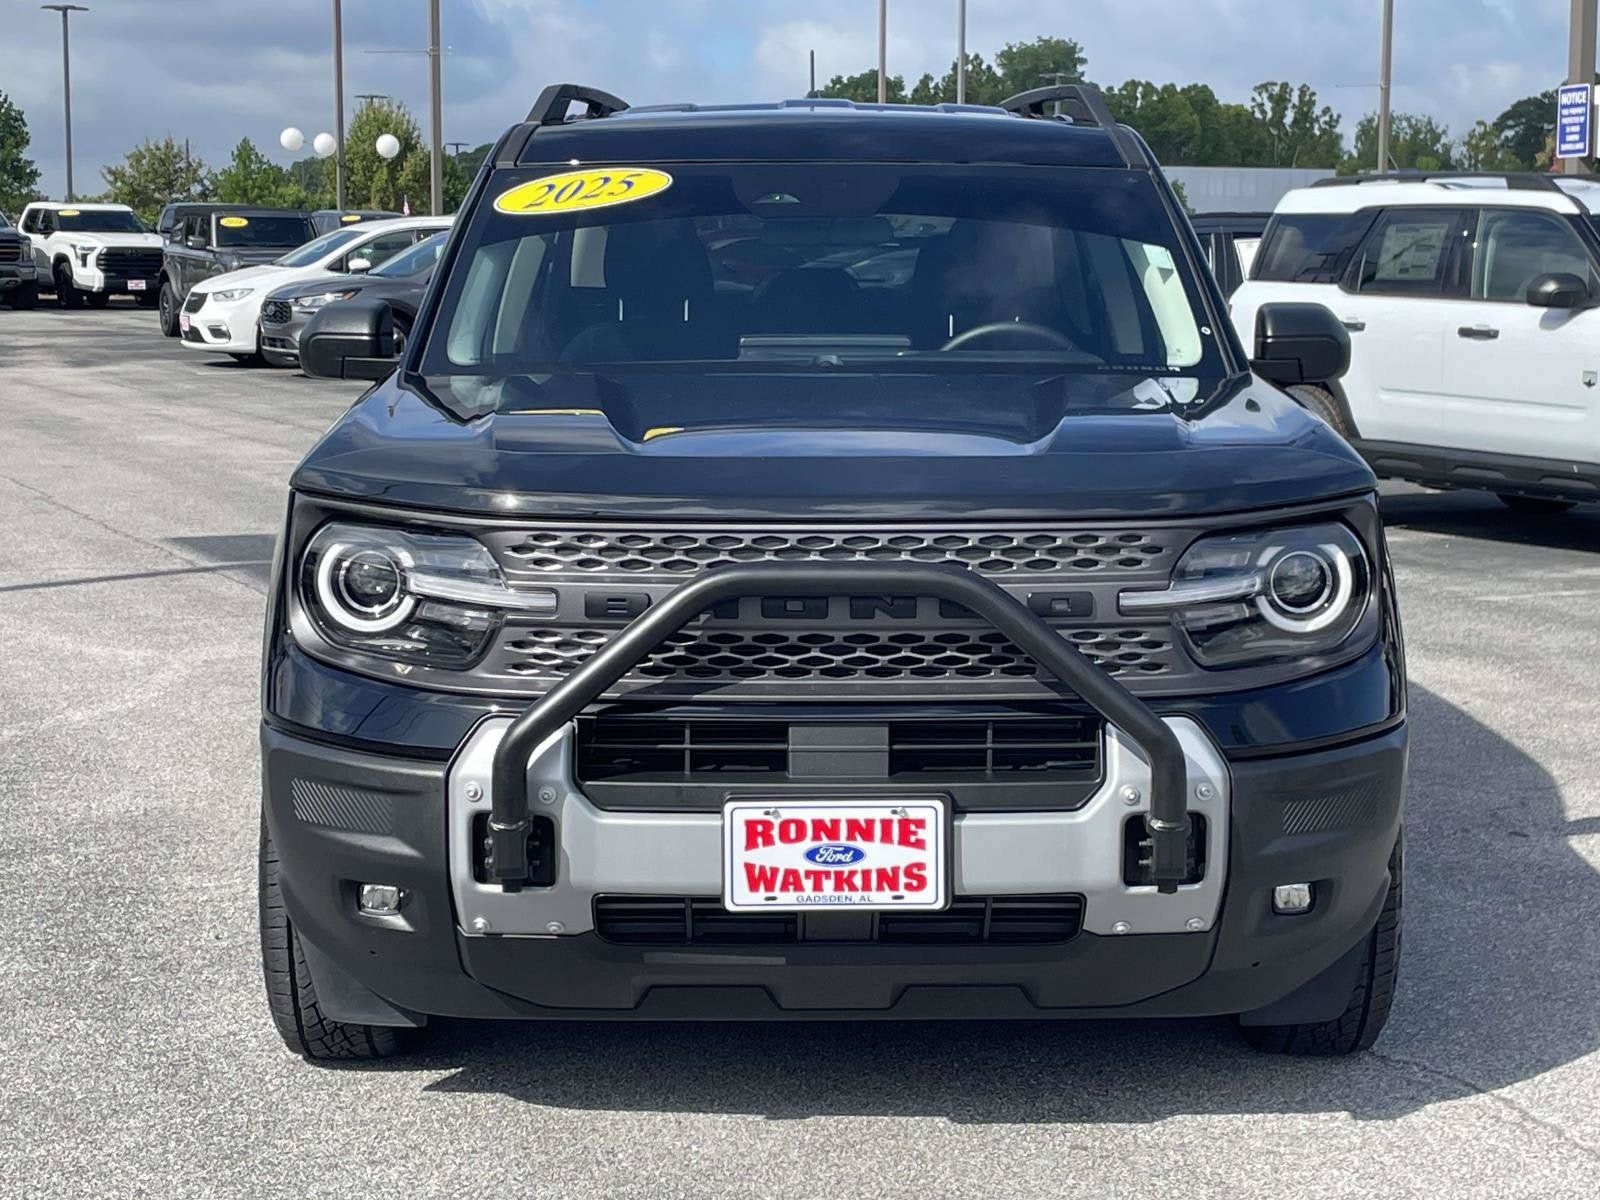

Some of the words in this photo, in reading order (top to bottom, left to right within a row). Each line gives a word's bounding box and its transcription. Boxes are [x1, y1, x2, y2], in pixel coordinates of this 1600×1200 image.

[1561, 91, 1586, 105] NOTICE
[523, 174, 643, 209] 2025
[744, 818, 927, 851] RONNIE
[815, 847, 854, 863] Ford
[744, 861, 928, 893] WATKINS
[796, 895, 855, 904] GADSDEN,
[859, 895, 873, 903] AL
